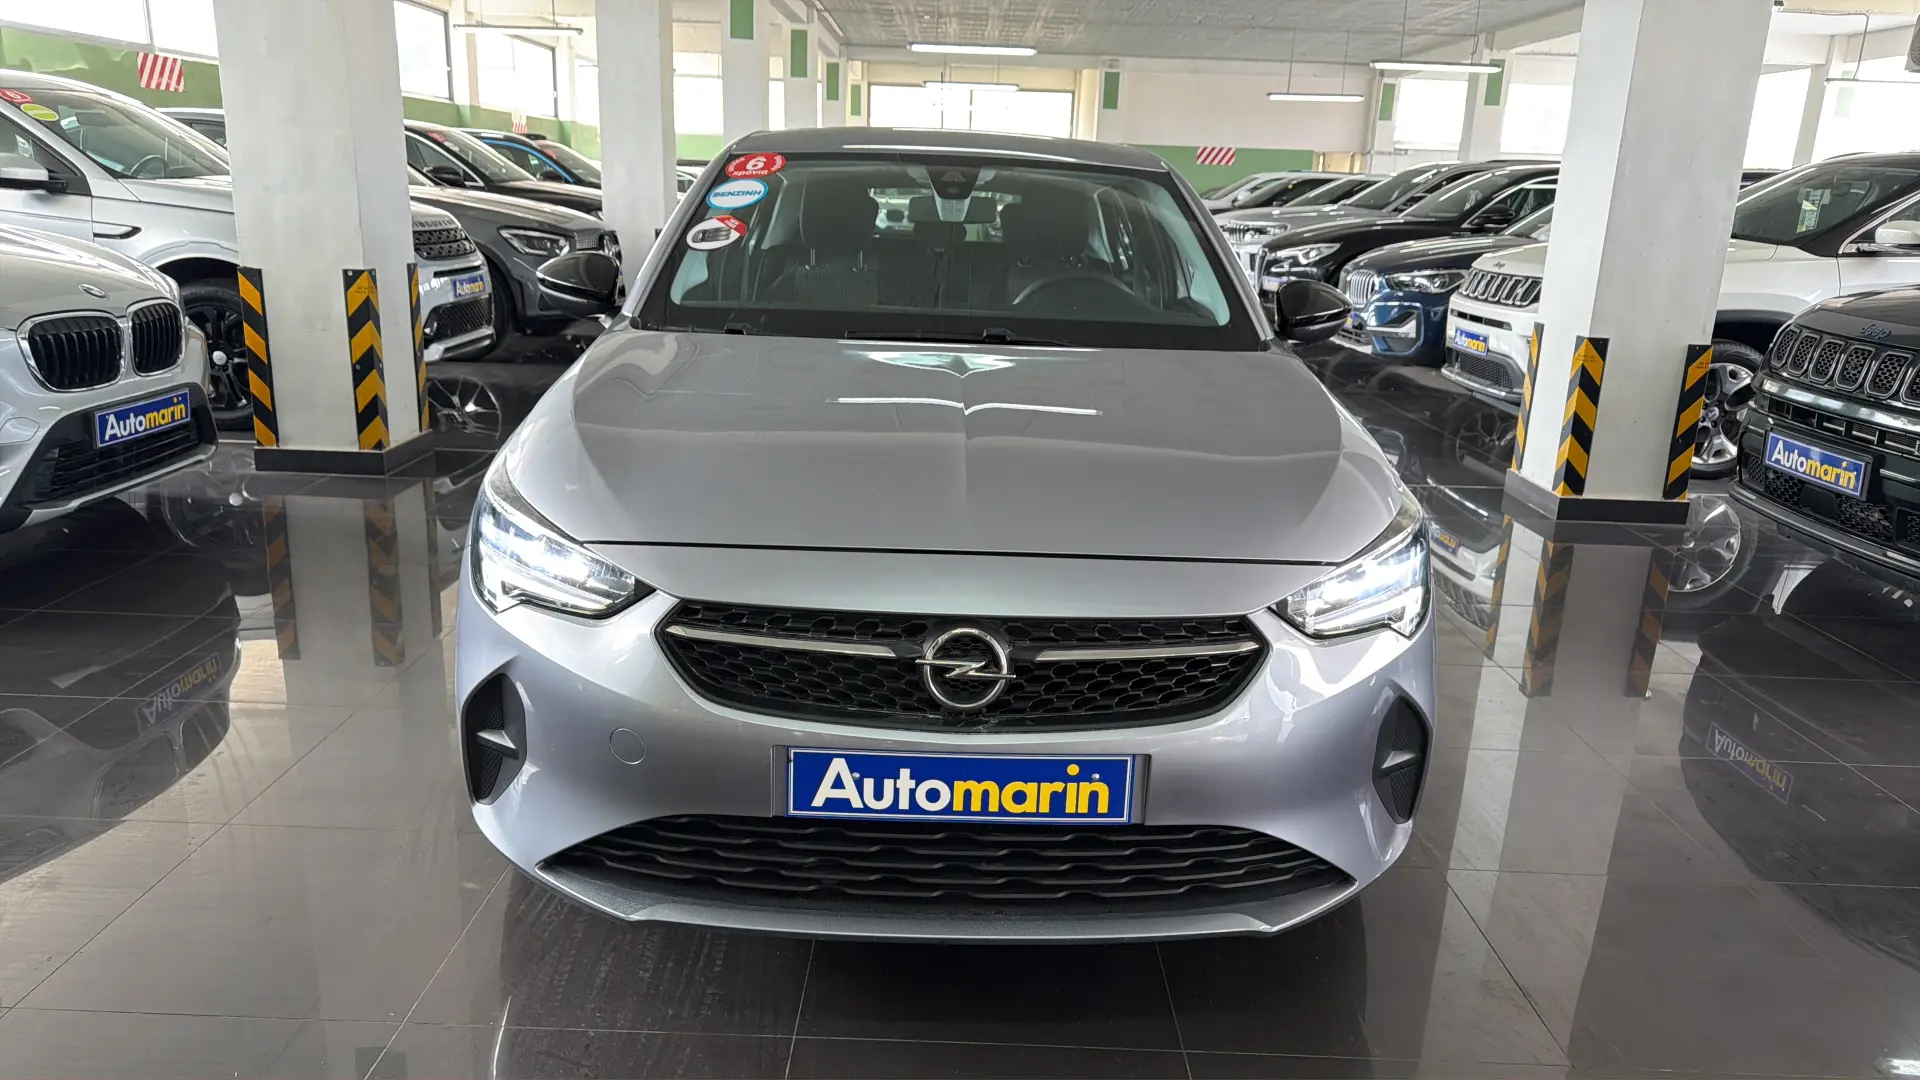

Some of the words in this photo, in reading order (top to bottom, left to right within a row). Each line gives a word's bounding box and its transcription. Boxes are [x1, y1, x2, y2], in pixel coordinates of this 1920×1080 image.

[746, 157, 767, 170] 6
[1860, 324, 1892, 340] Jeep
[105, 397, 186, 441] Automarin
[1771, 440, 1856, 489] Automarin
[811, 757, 1109, 813] Automarin
